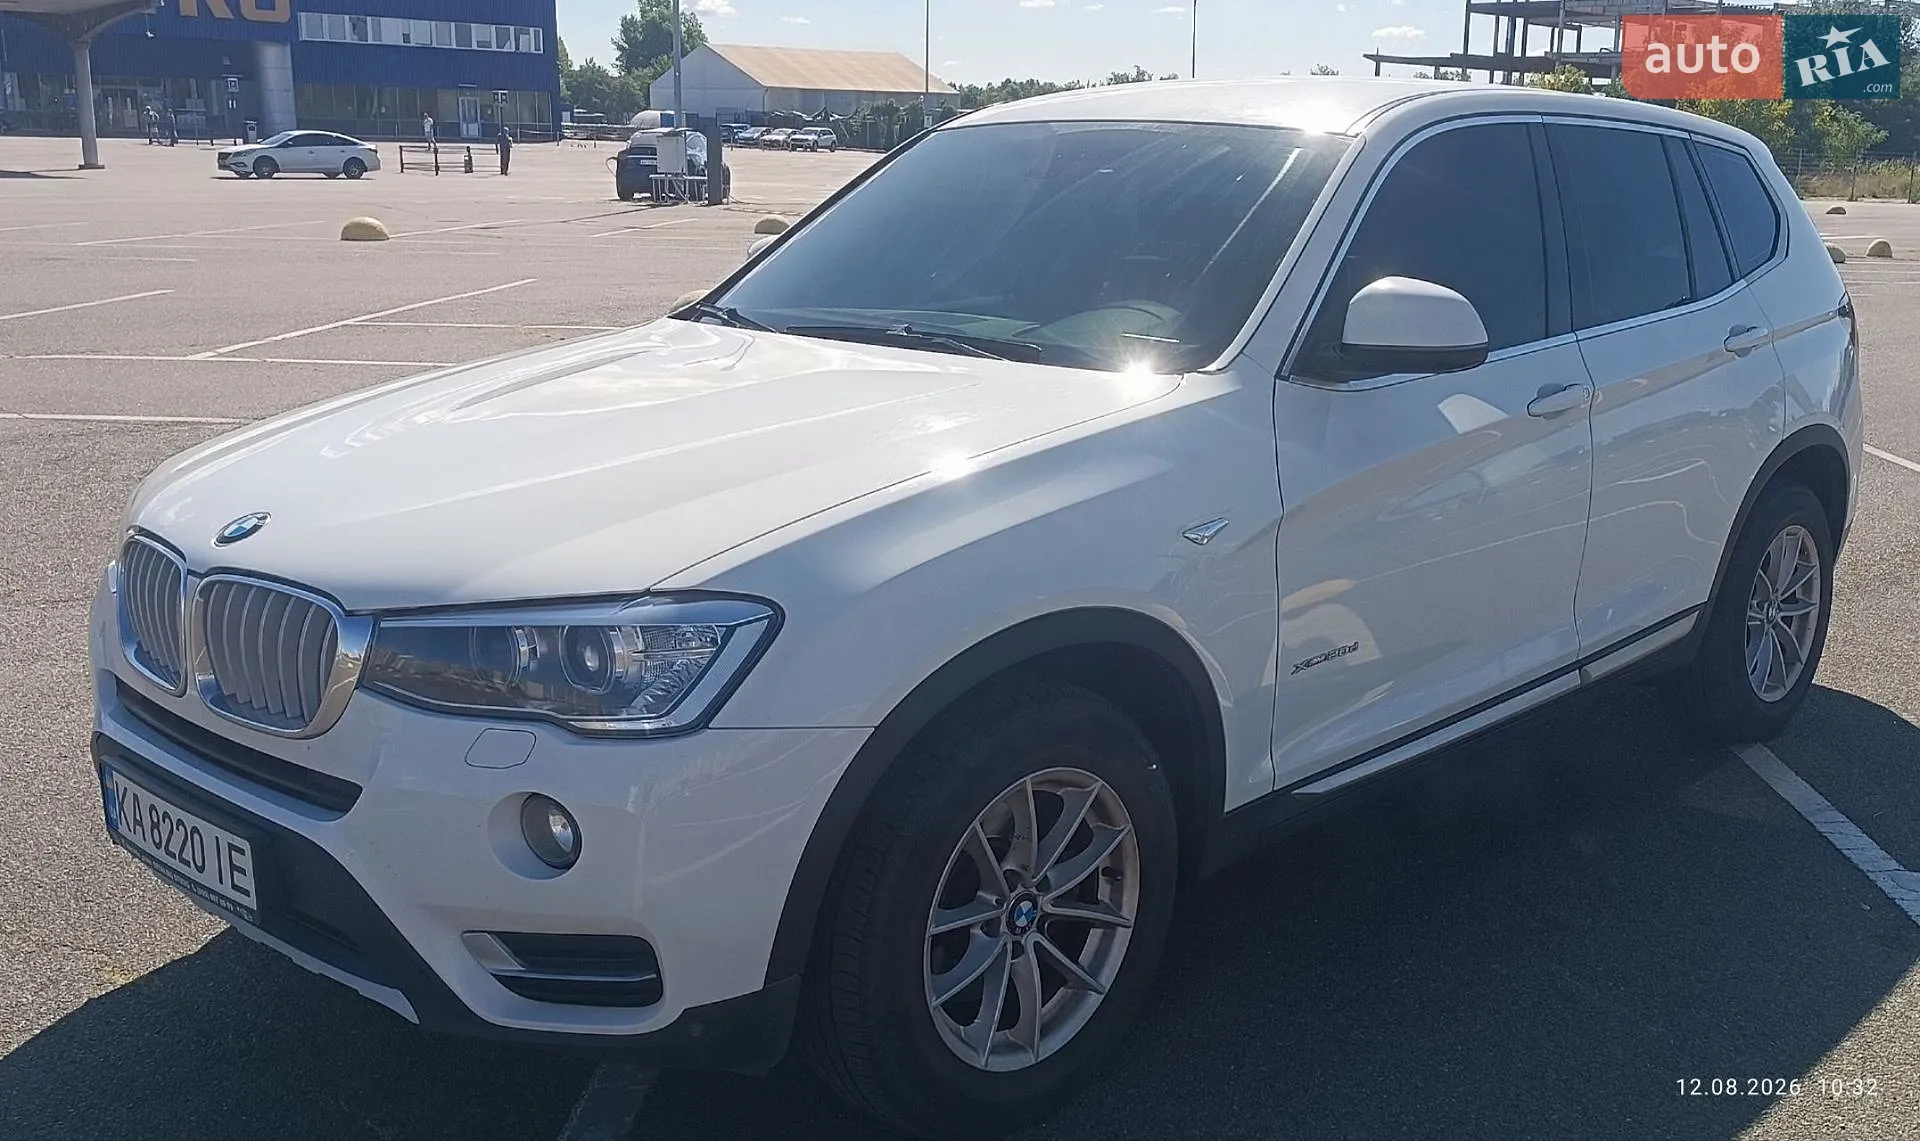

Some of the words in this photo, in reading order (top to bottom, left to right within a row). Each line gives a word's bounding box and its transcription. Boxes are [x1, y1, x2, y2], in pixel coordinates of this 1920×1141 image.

[115, 781, 146, 842] KA
[149, 803, 206, 874] 8220
[215, 836, 251, 898] IE
